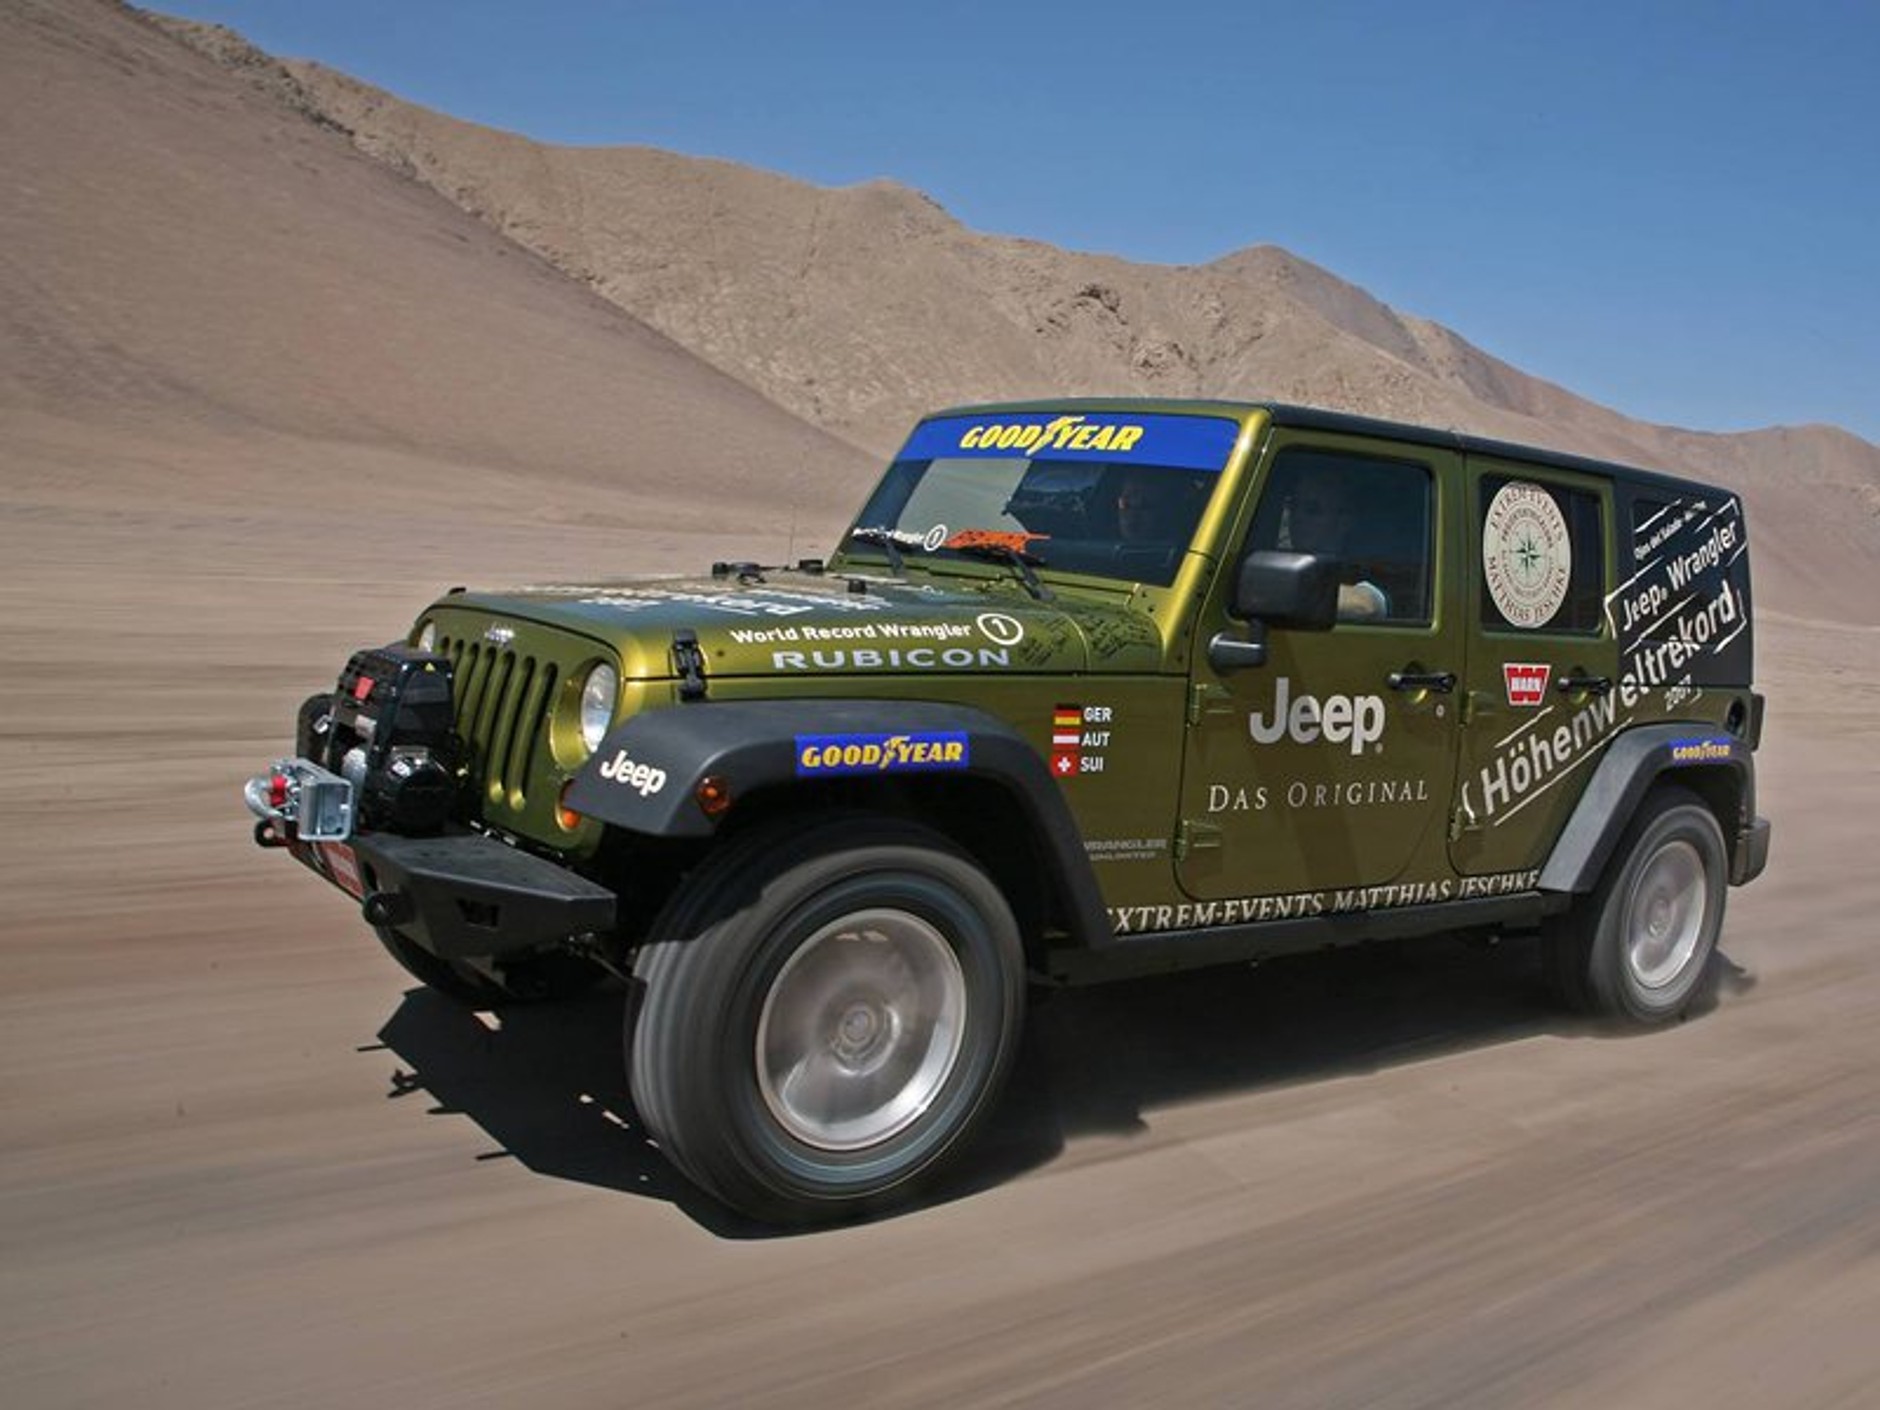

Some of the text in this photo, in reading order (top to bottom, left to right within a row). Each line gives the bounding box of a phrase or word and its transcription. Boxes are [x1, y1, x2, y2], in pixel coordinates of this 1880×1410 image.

[959, 416, 1144, 456] GOODYEAR
[1666, 521, 1737, 592] Wrangler
[731, 626, 797, 645] World
[801, 623, 876, 642] Record
[877, 621, 971, 643] Wrangler
[772, 648, 1010, 670] RUBICON
[1084, 707, 1112, 723] GER
[1481, 580, 1738, 815] Höhenweltrekord
[1249, 677, 1385, 755] Jeep
[801, 735, 964, 770] GOODYEAR
[1081, 732, 1111, 748] AUT
[599, 750, 667, 797] Jeep
[1080, 757, 1104, 773] SUI
[1208, 780, 1429, 812] DAS ORIGINAL
[1106, 870, 1540, 934] XTREM-EVENTS MATTHIAS JESCHKE
